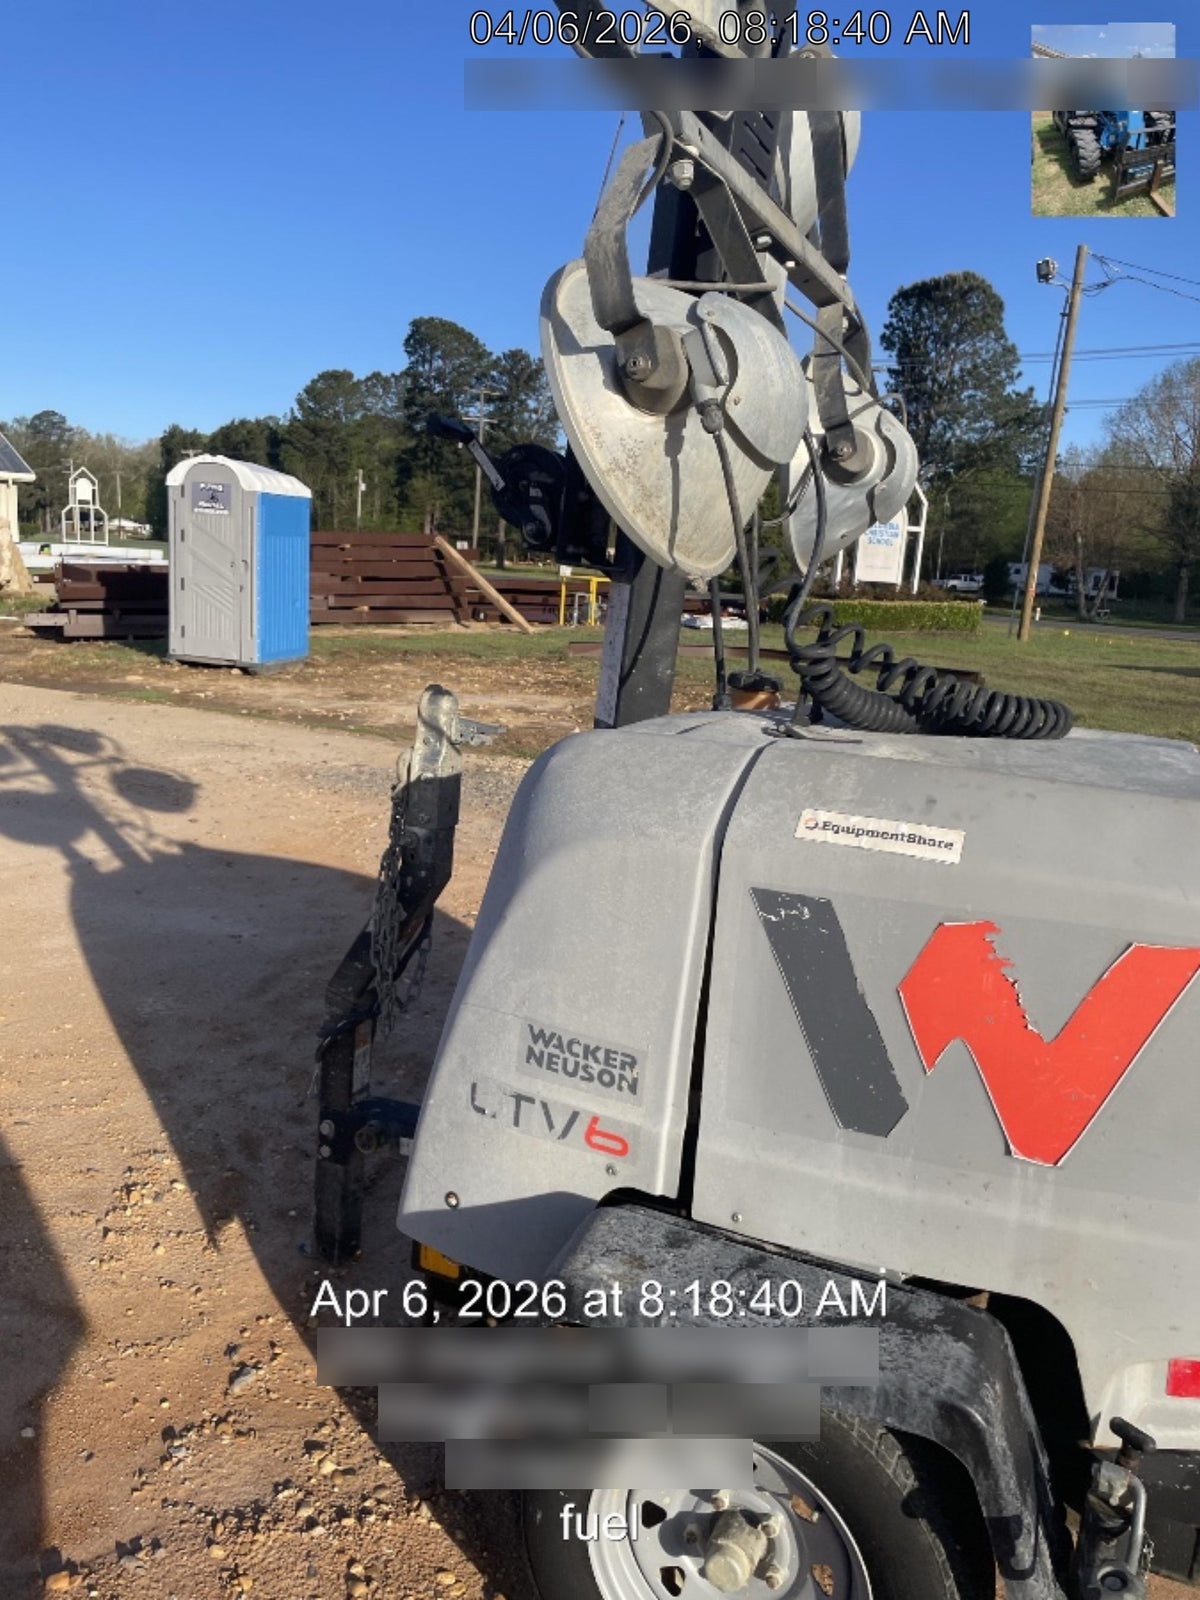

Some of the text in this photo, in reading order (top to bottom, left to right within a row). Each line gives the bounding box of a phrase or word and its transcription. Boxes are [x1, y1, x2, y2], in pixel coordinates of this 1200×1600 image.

[821, 820, 954, 851] EquipmentShare
[525, 1044, 639, 1096] NEUSON
[527, 1023, 638, 1073] WACKER
